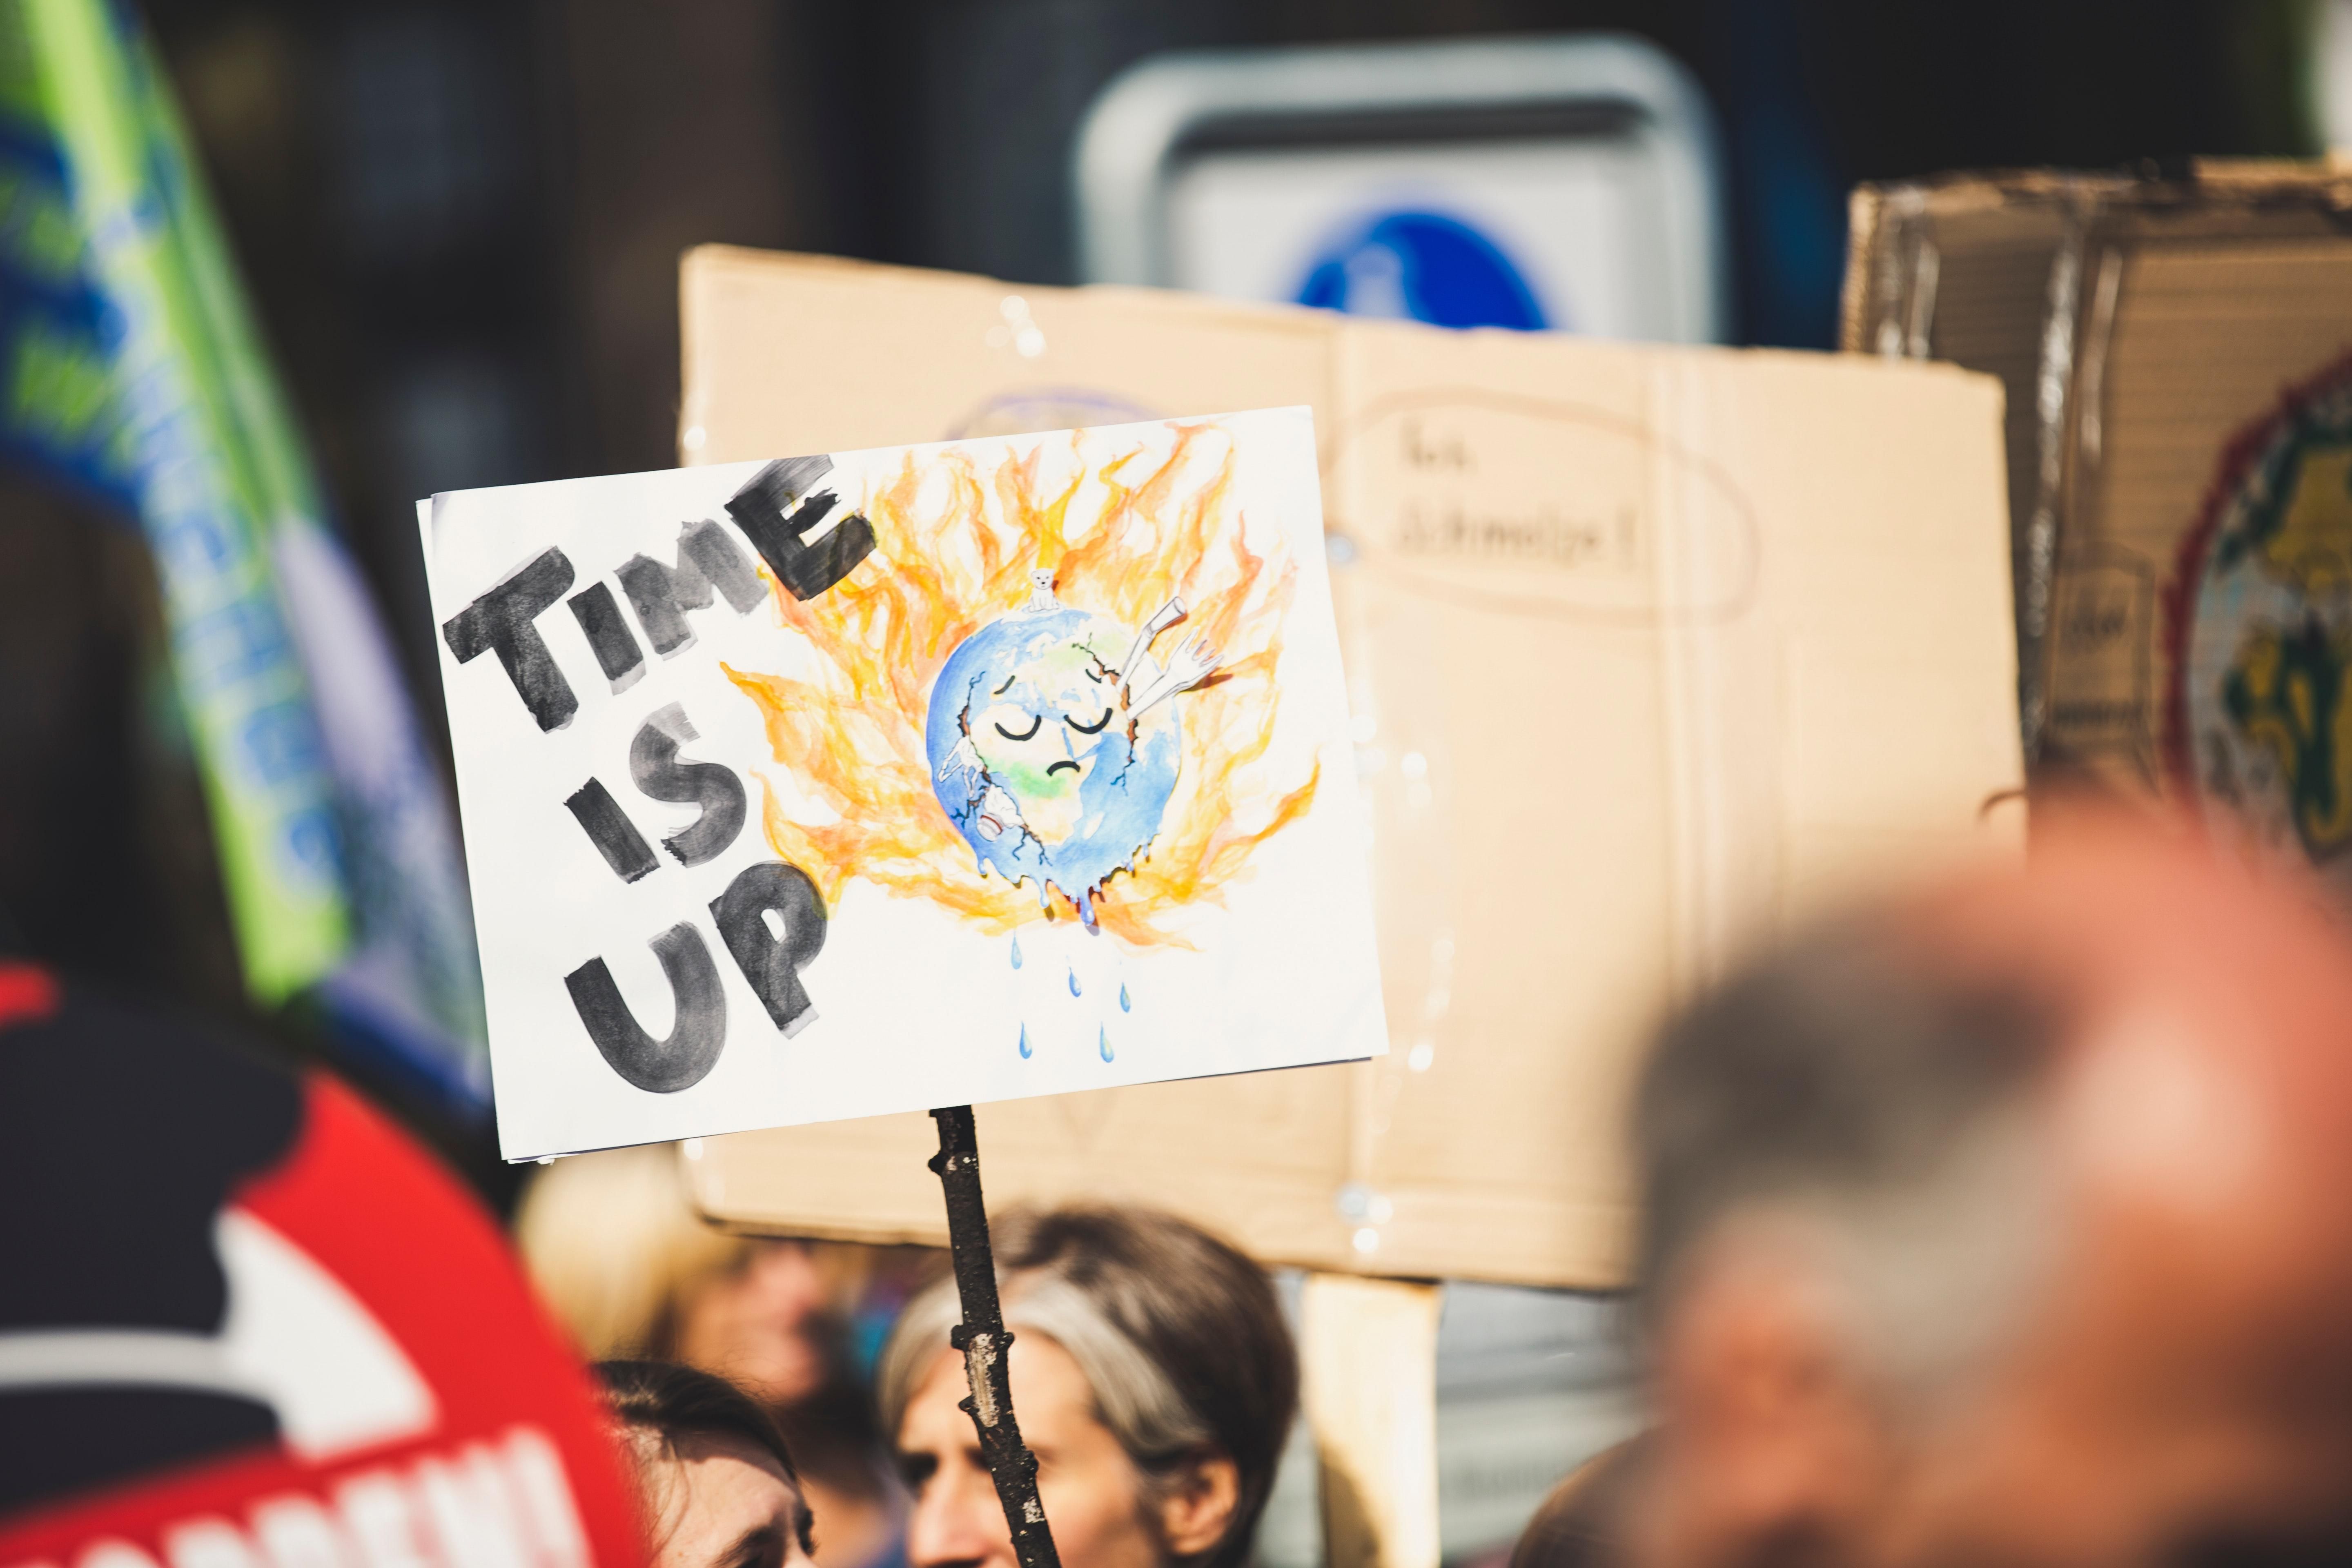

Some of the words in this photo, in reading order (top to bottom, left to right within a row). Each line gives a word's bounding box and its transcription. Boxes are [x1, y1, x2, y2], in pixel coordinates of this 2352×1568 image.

[443, 454, 876, 734] TIME
[564, 701, 747, 884] IS
[564, 860, 828, 1095] UP
